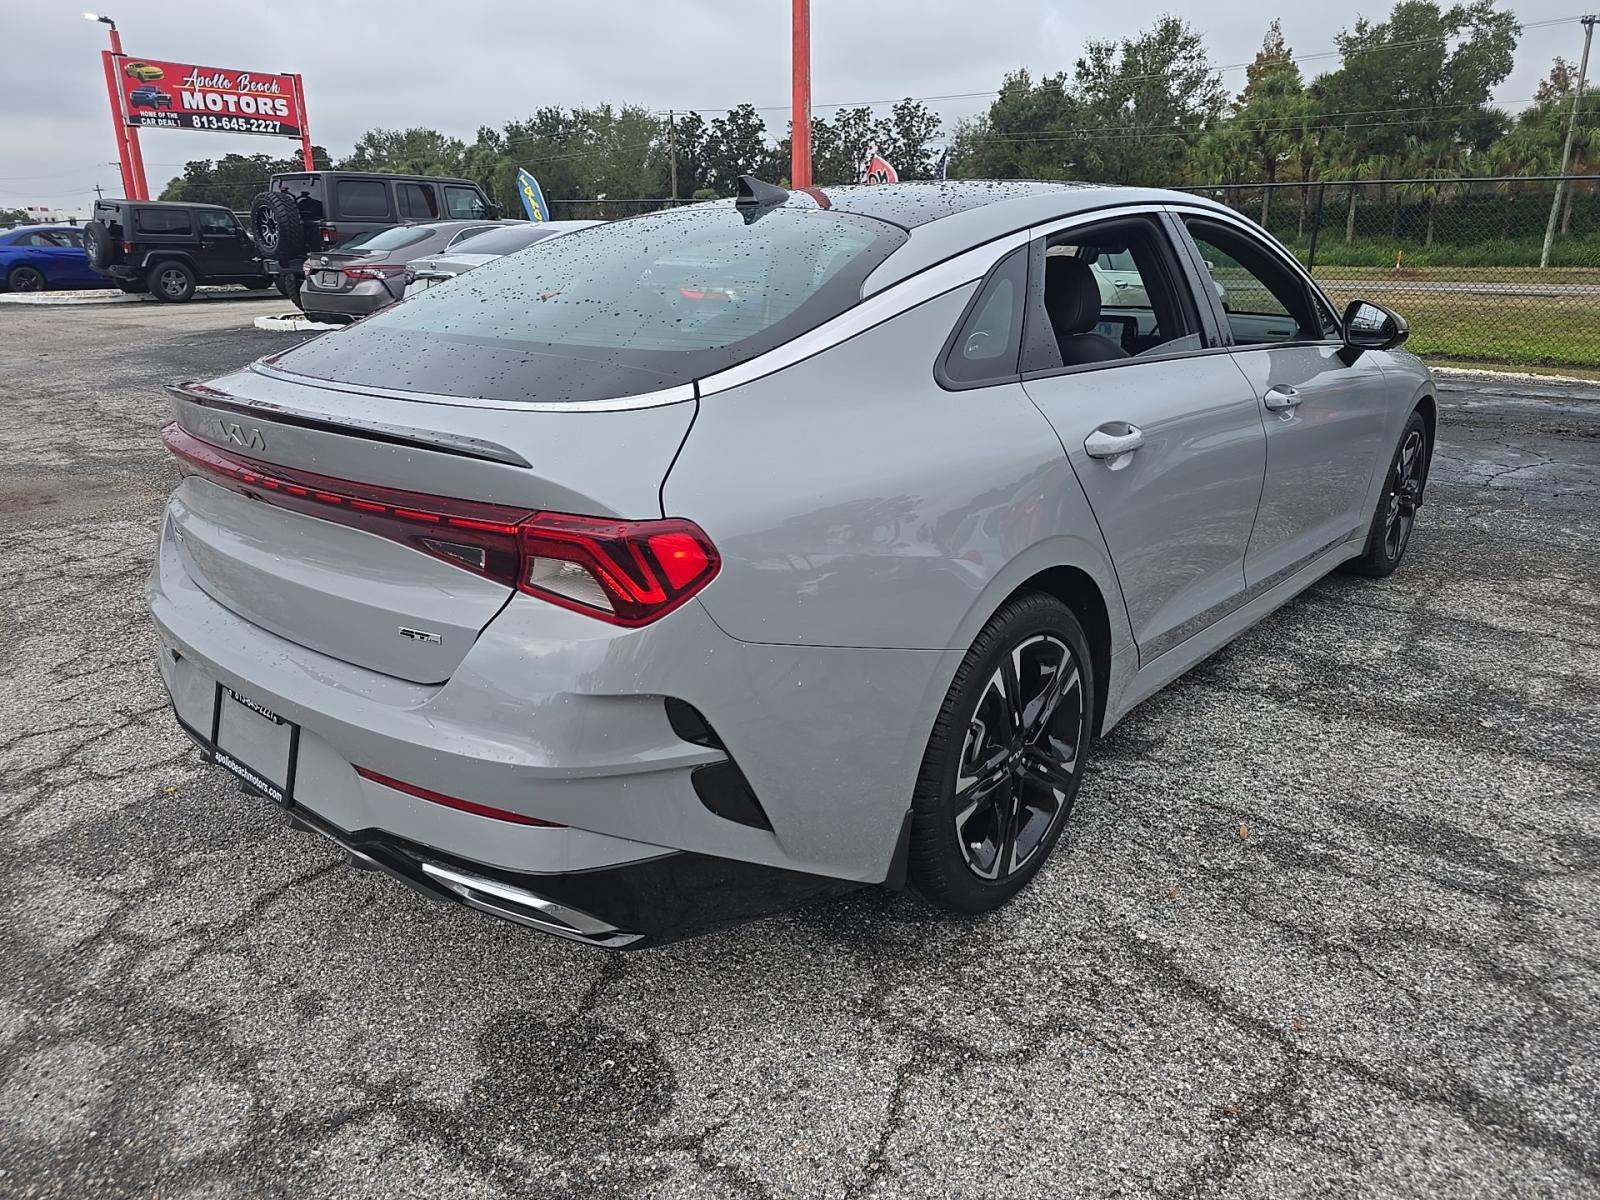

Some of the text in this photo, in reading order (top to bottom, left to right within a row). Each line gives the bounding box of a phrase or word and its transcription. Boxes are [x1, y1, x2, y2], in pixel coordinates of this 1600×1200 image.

[183, 68, 281, 94] Apollo Beach
[140, 111, 157, 119] HOME
[181, 91, 289, 117] MOTORS
[141, 118, 157, 126] CAR
[192, 115, 281, 133] 813-645-2227
[215, 751, 283, 803] apollobeachmotors.com
